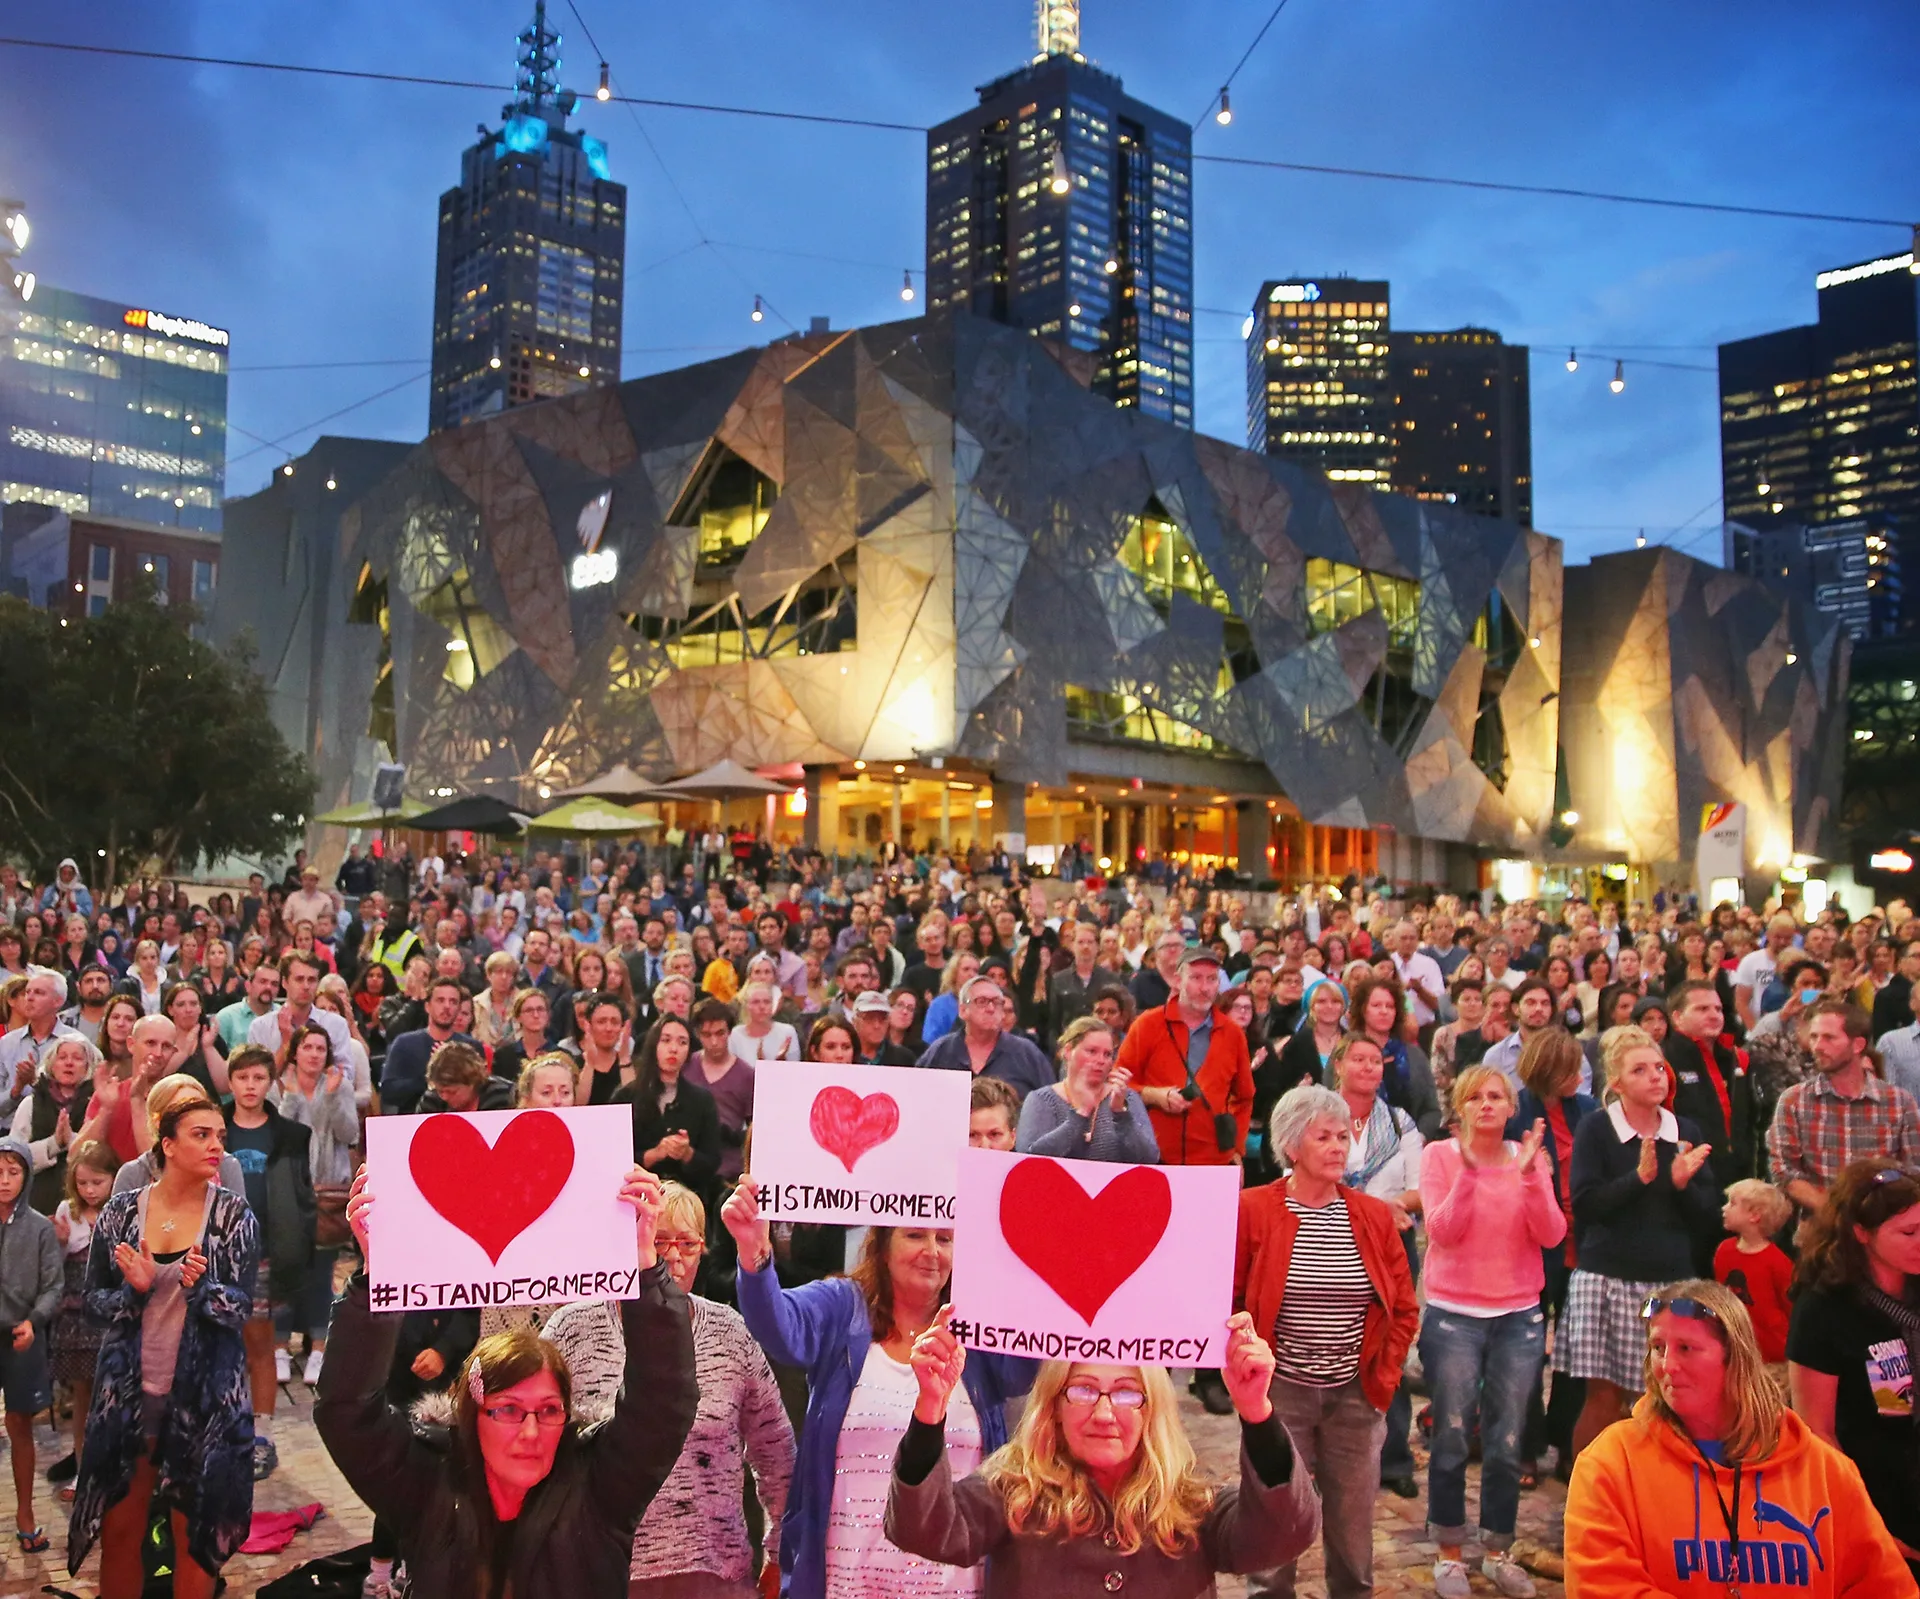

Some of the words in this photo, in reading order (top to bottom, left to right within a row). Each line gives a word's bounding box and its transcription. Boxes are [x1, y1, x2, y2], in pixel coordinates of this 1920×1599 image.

[371, 1268, 638, 1307] #ISTANDFORMERCY
[949, 1318, 1209, 1362] #ISTANDFORMERCY
[1673, 1539, 1809, 1587] PUMA
